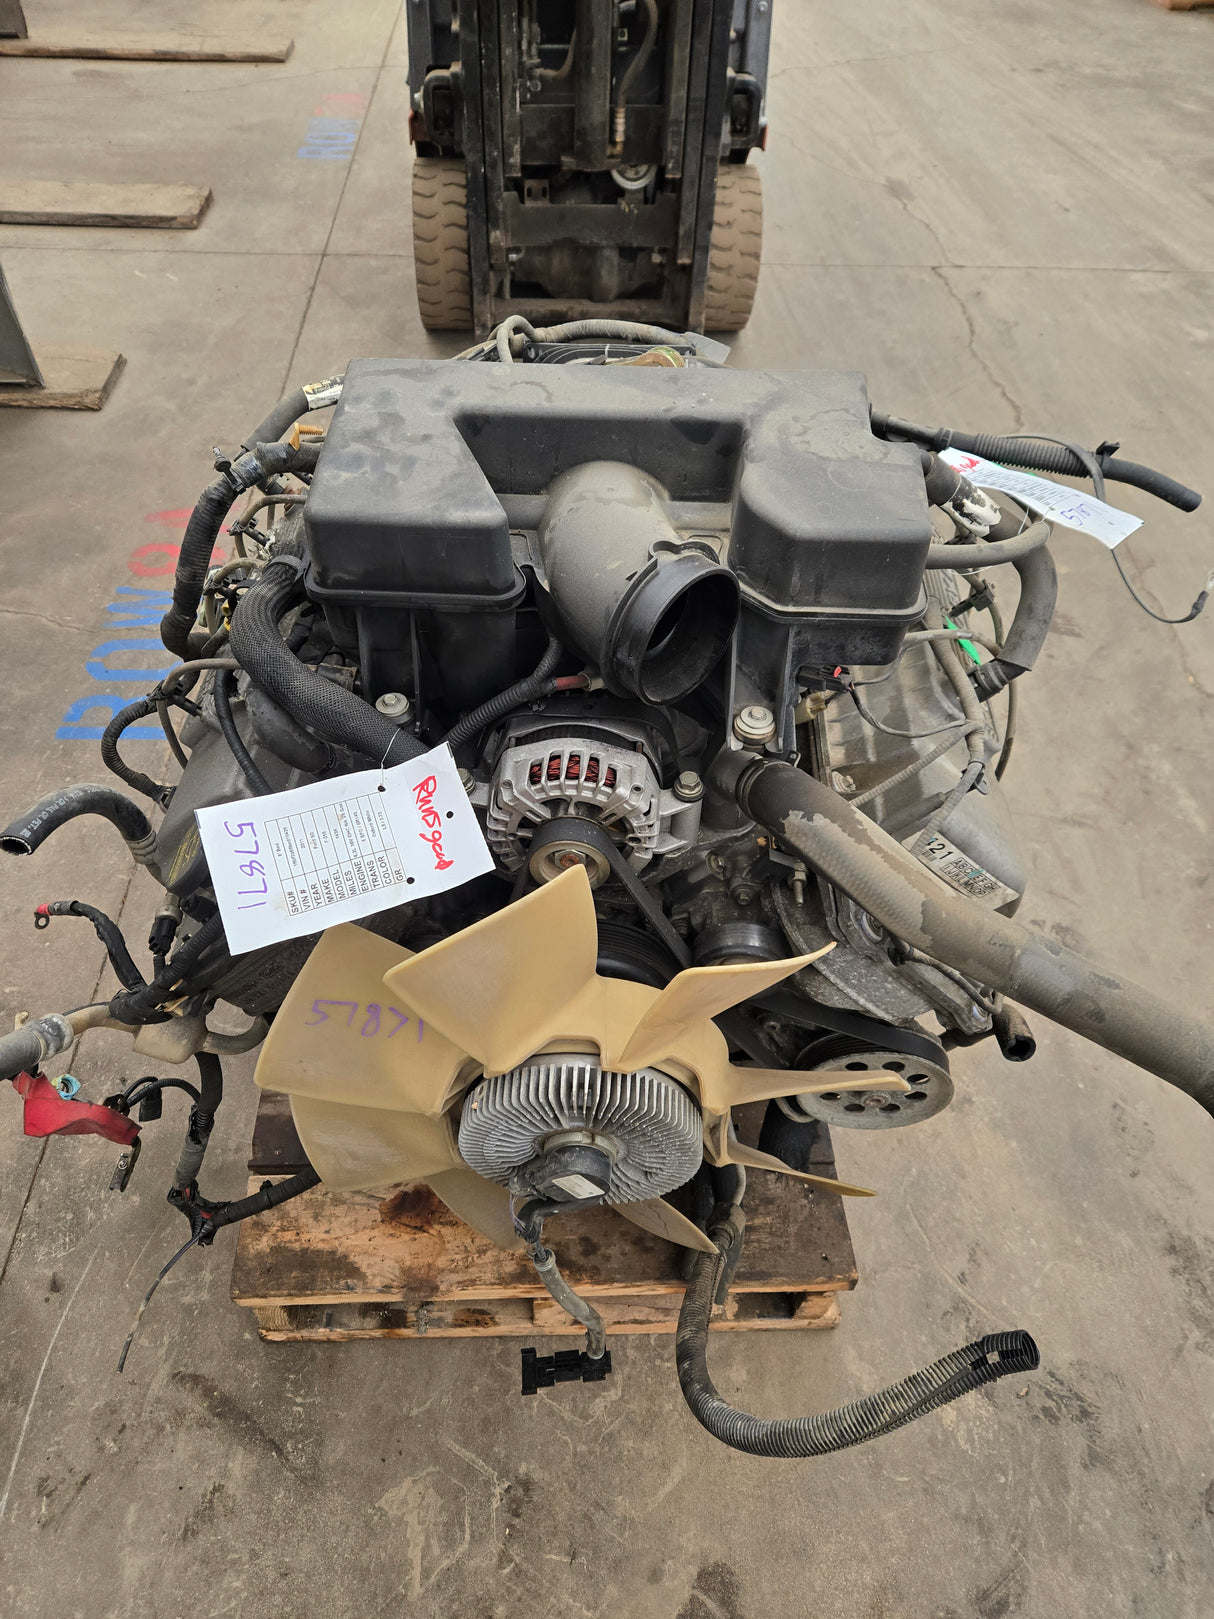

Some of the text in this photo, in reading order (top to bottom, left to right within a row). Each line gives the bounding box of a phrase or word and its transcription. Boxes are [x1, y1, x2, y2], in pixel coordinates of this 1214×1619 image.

[55, 584, 203, 740] ROW
[224, 821, 267, 910] 57871
[354, 860, 369, 892] ENGINE
[367, 860, 380, 888] TRANS
[378, 855, 392, 885] COLOR
[394, 868, 404, 881] GR
[311, 883, 322, 907] YEAR
[322, 878, 335, 903] MAKE
[332, 869, 346, 899] MODEL
[344, 870, 357, 896] MILES
[286, 890, 300, 914] SKU#
[301, 895, 311, 911] VIN
[304, 999, 423, 1043] 57871
